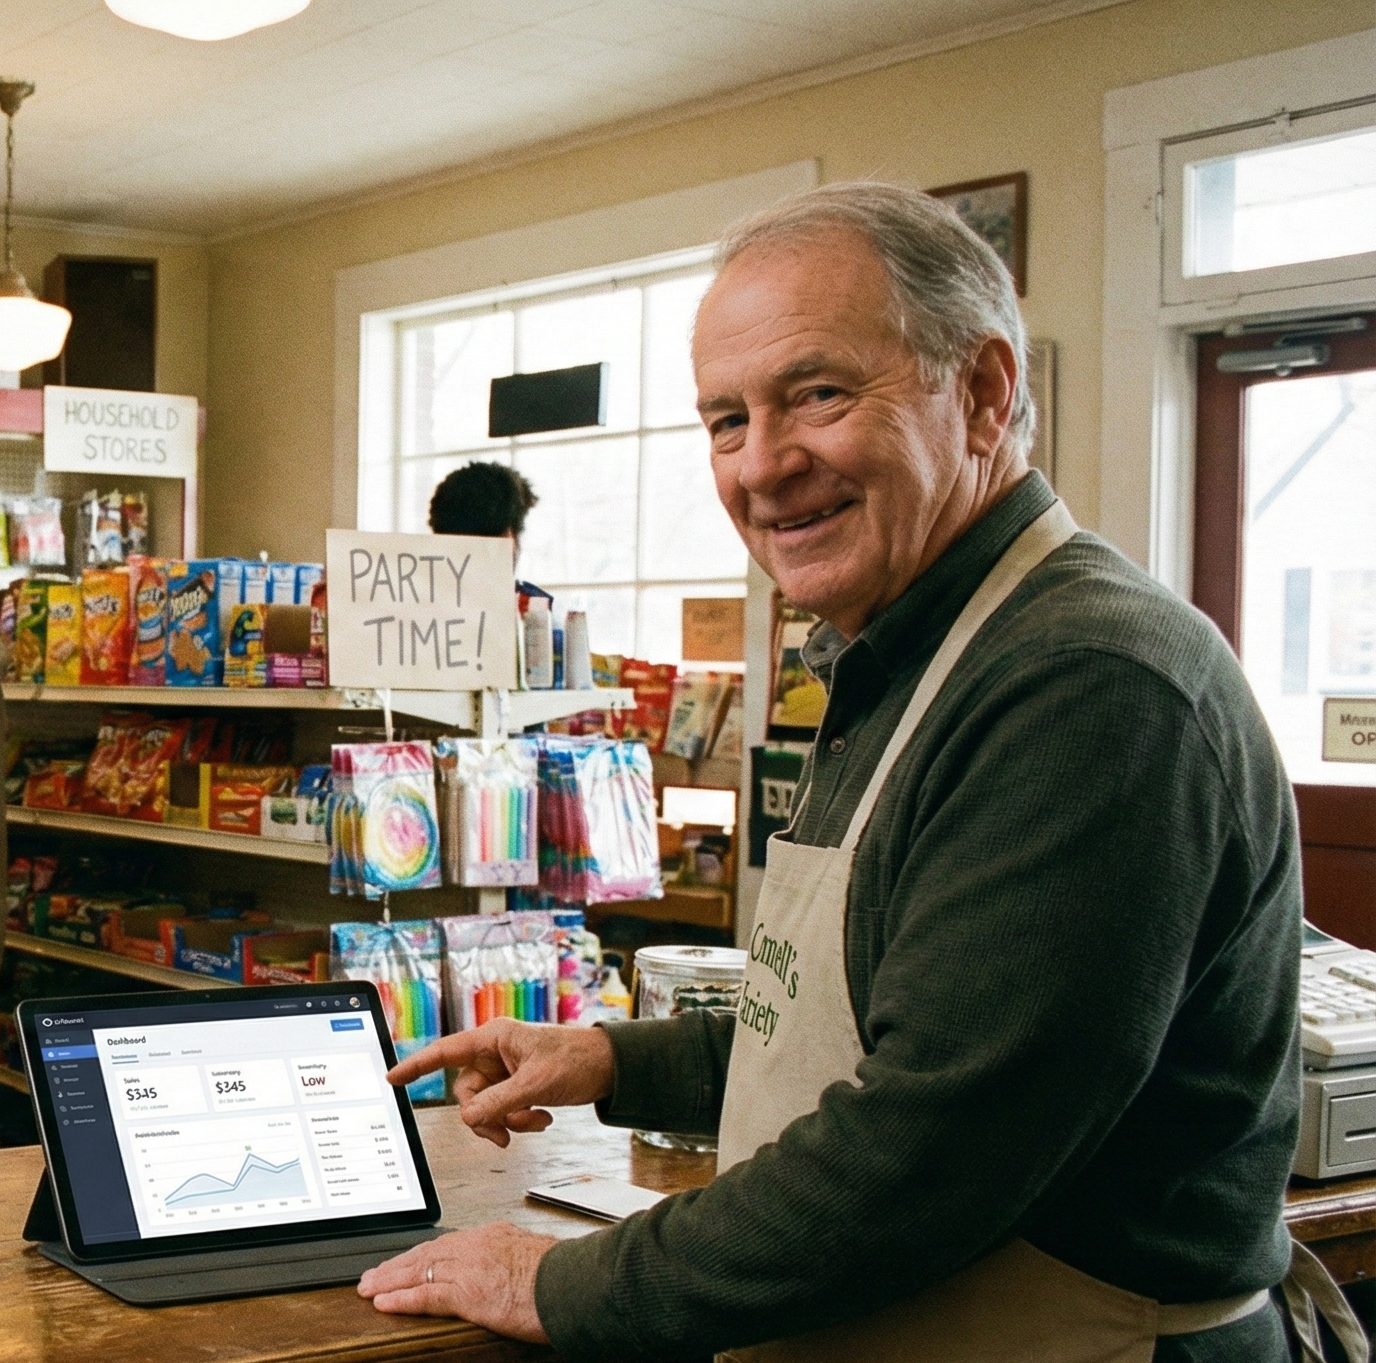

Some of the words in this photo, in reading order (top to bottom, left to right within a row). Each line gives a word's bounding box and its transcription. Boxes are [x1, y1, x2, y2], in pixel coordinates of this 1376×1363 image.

[65, 400, 180, 432] HOUSEHOLD
[83, 435, 167, 464] STORES
[349, 548, 472, 608] PARTY
[364, 611, 486, 671] TIME!
[301, 1076, 326, 1087] Low
